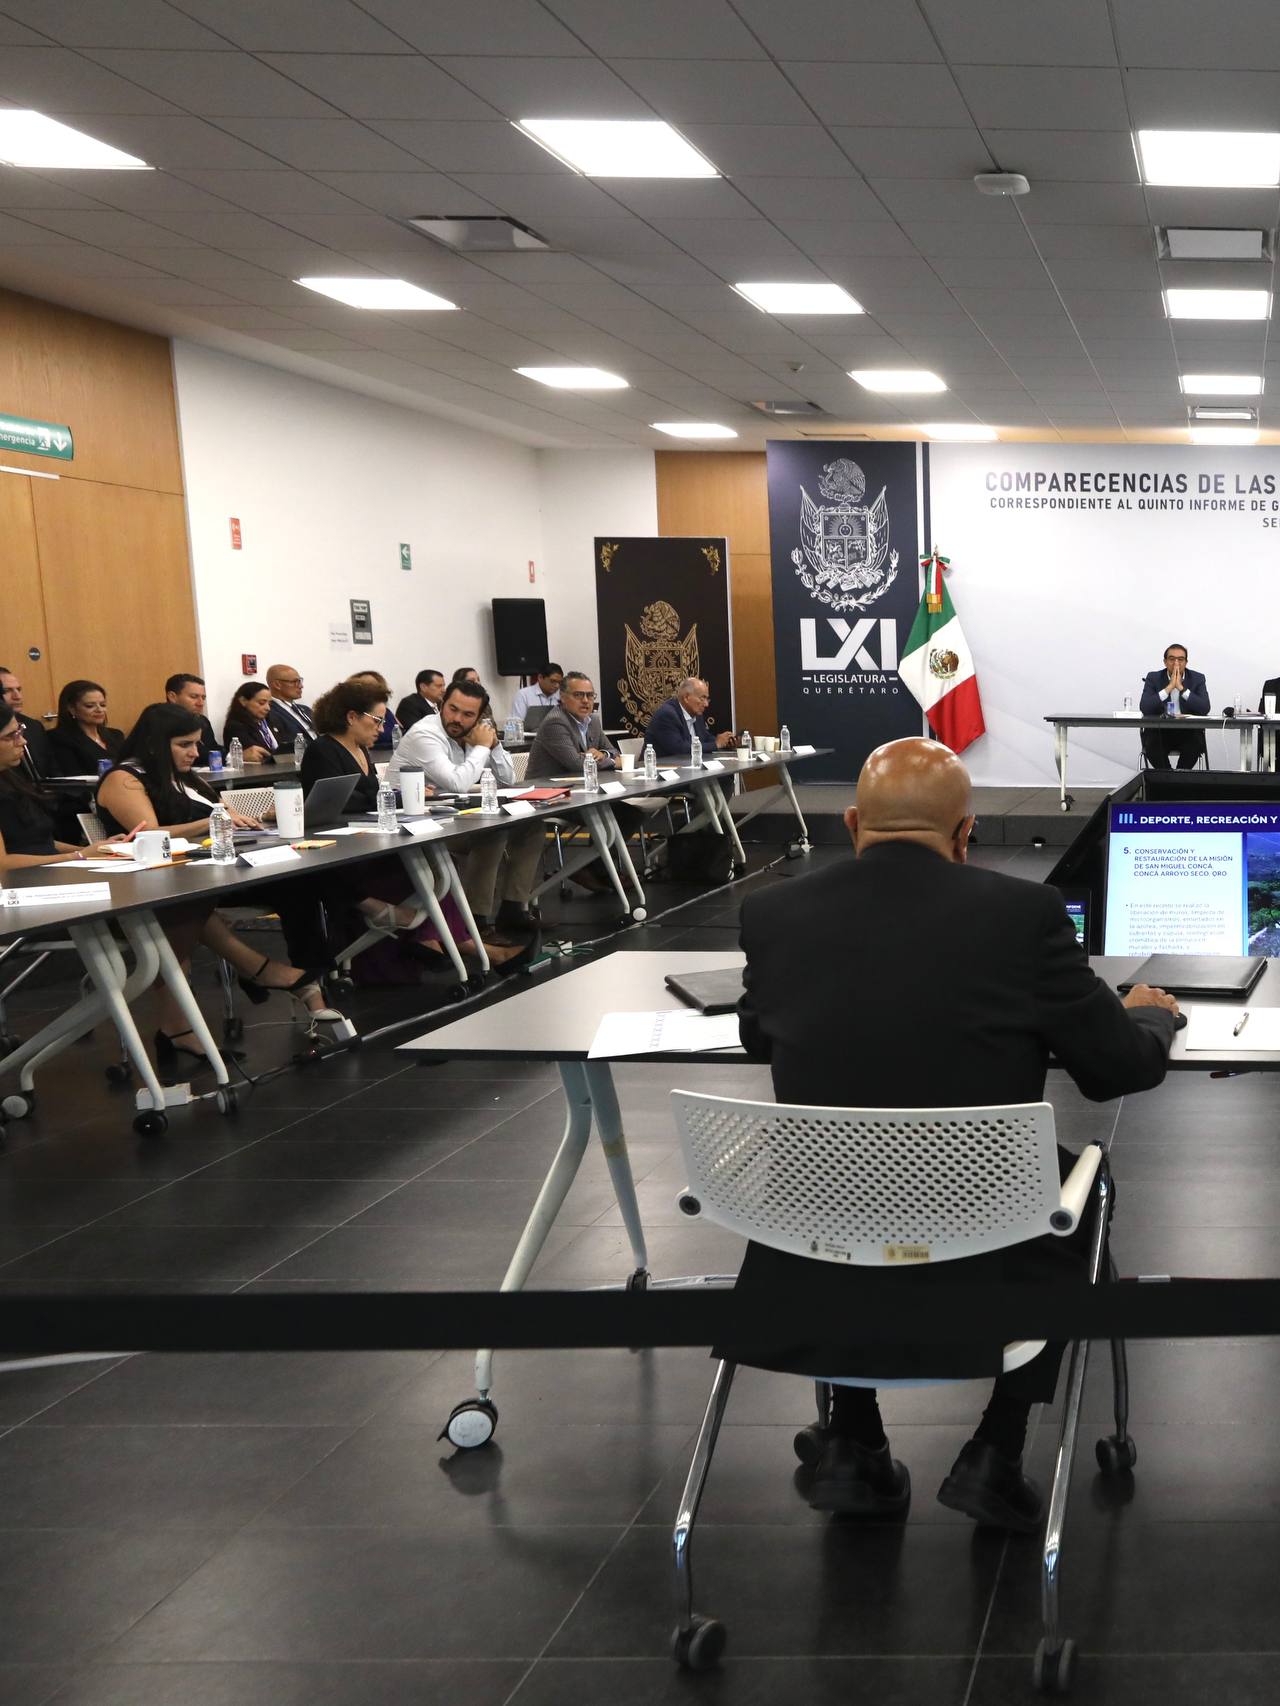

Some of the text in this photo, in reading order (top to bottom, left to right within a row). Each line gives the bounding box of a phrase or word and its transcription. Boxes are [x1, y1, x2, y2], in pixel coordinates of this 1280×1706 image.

[985, 471, 1188, 493] COMPARECENCIAS
[1198, 474, 1225, 494] DE
[1235, 475, 1276, 494] LAS
[990, 497, 1112, 510] CORRESPONDIENTE
[1117, 498, 1133, 510] AL
[1138, 498, 1184, 511] QUINTO
[1189, 499, 1246, 511] INFORME
[1251, 500, 1267, 511] DE
[800, 618, 898, 671] LXI
[813, 673, 887, 684] LEGISLATURA
[803, 686, 899, 695] QUERÉTARO
[1140, 815, 1194, 825] DEPORTE,
[1196, 813, 1268, 825] RECREACIÓN
[1270, 815, 1278, 824] Y
[1134, 847, 1189, 855] CONSERVACIÓN
